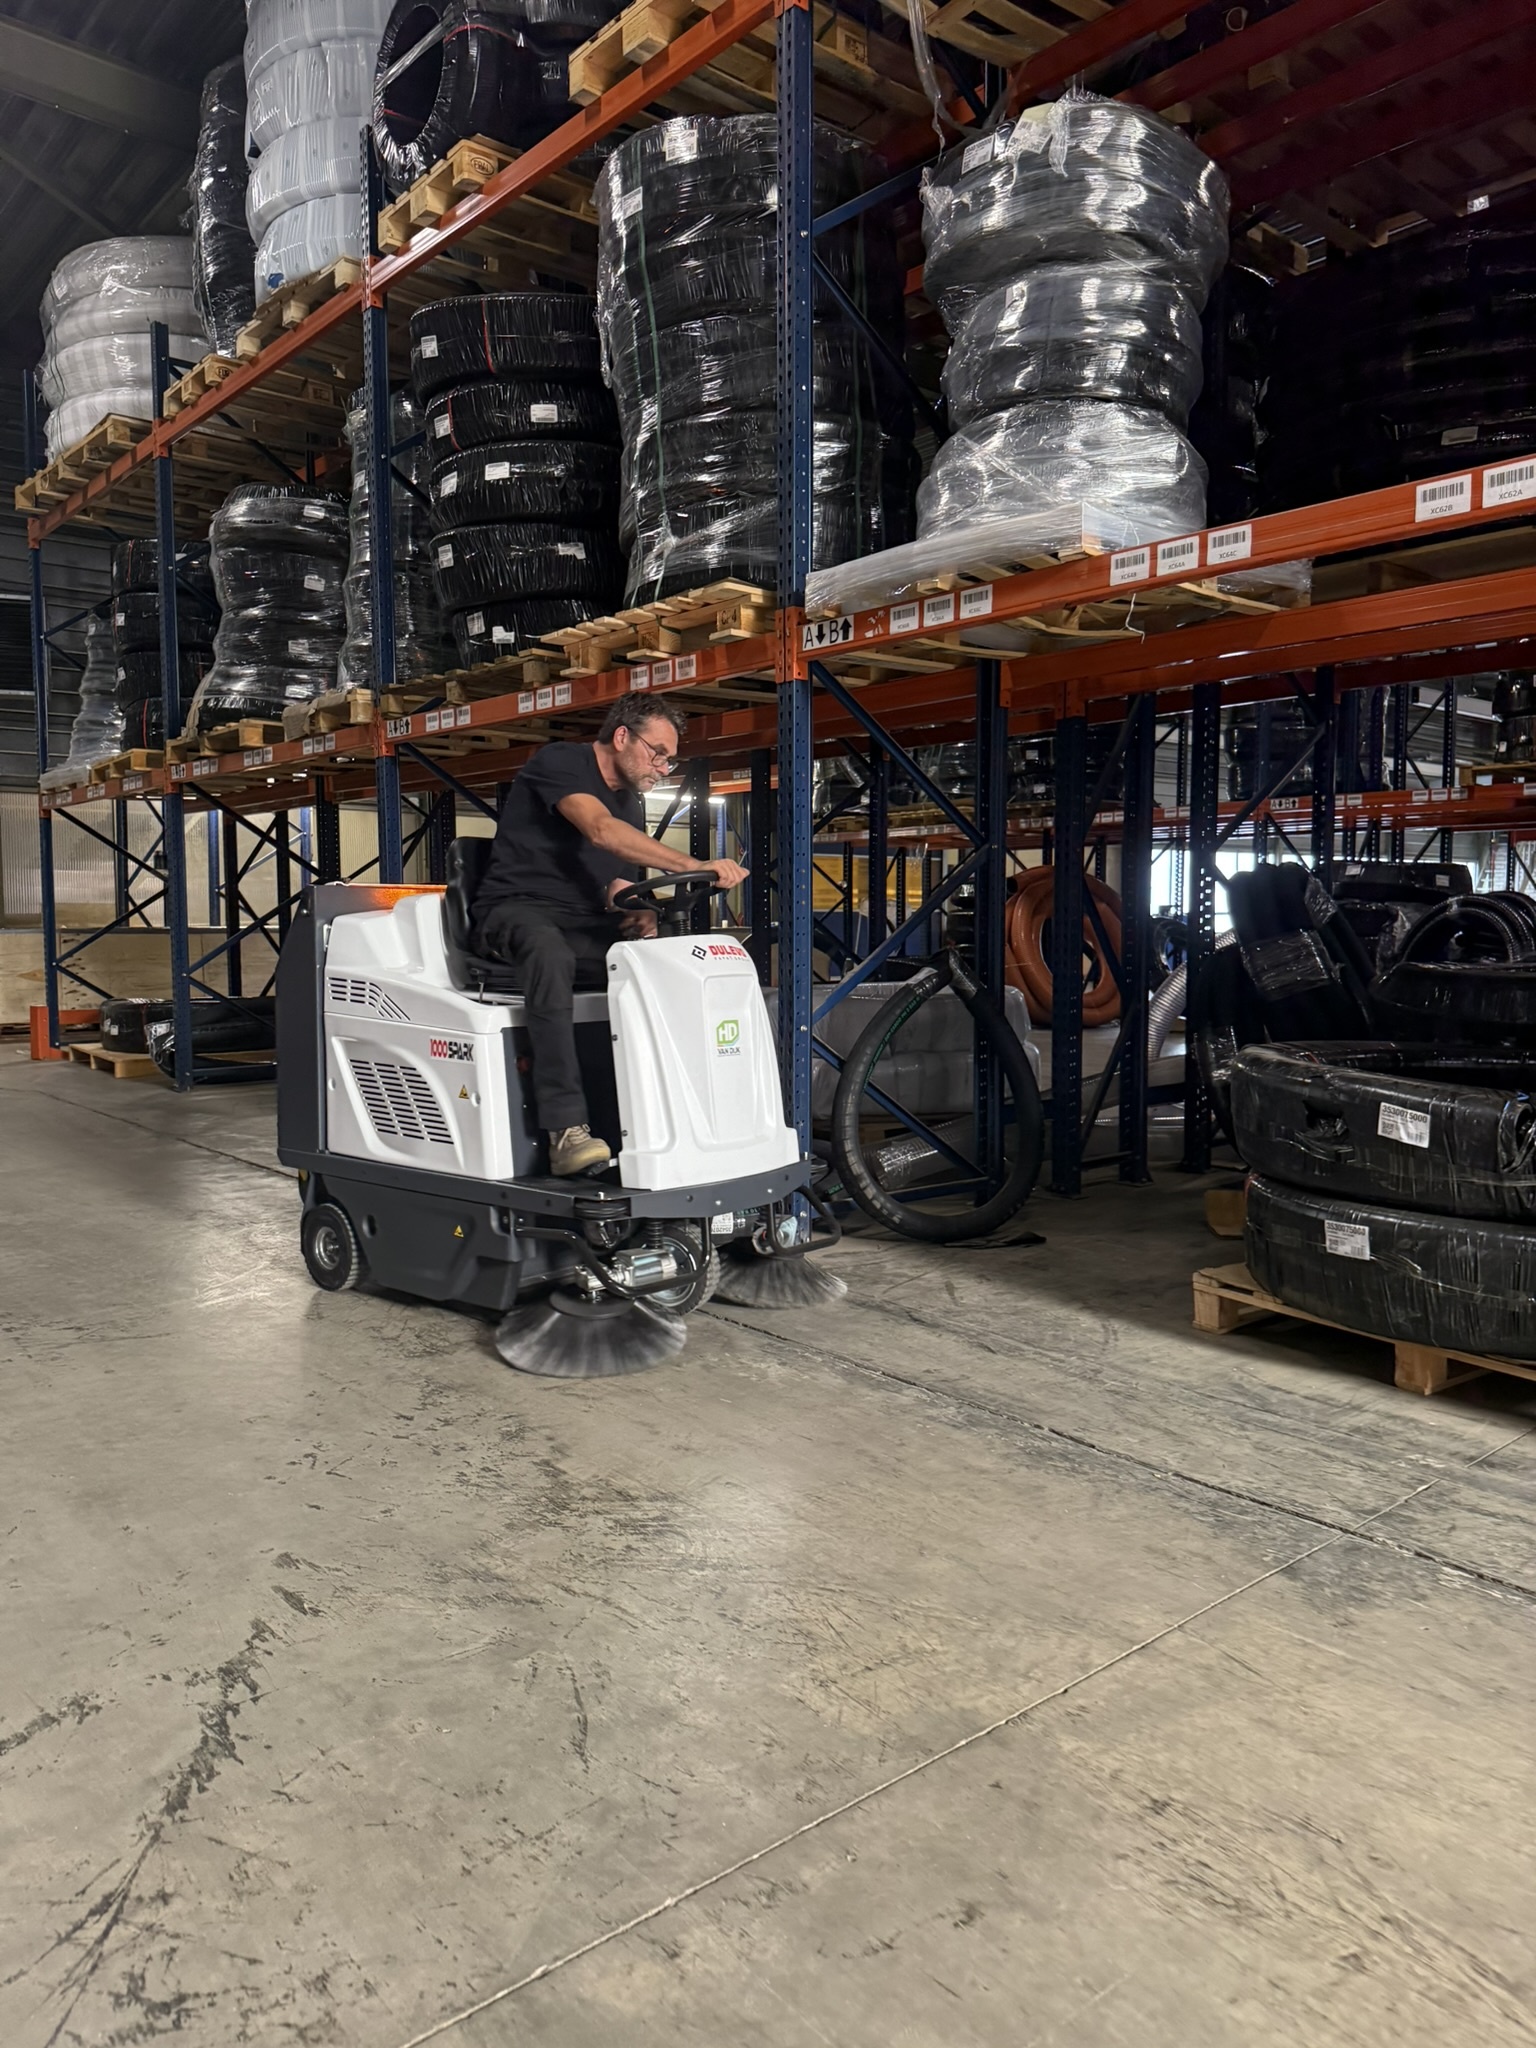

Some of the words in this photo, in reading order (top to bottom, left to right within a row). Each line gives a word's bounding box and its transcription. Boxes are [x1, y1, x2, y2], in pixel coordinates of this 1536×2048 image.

[1498, 488, 1523, 500] XC62A
[1430, 504, 1453, 515] XC62B
[804, 626, 814, 648] A
[829, 620, 840, 645] B
[388, 722, 393, 736] A
[399, 719, 405, 735] B
[719, 1022, 738, 1042] HD
[1382, 1104, 1428, 1124] 3530075000
